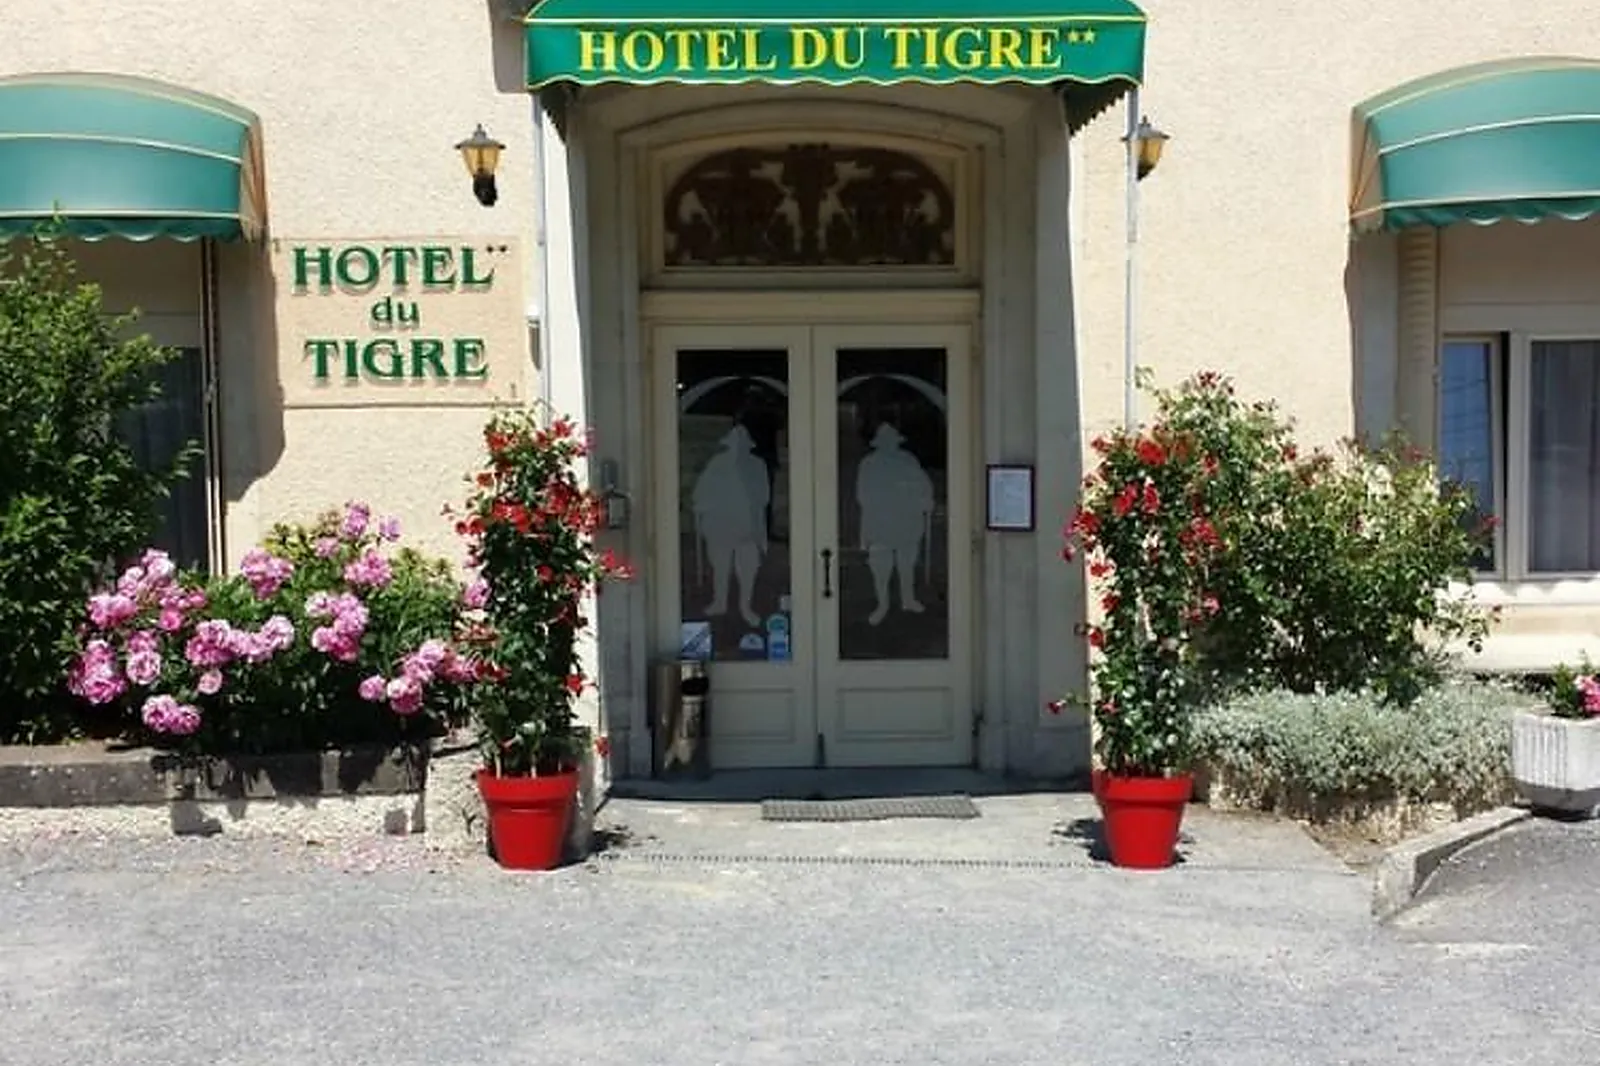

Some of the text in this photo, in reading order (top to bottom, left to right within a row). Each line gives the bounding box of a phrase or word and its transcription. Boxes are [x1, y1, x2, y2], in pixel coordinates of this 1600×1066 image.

[578, 27, 1062, 72] HOTEL DU TIGRE
[293, 246, 495, 286] HOTEL
[371, 295, 419, 322] du
[303, 338, 489, 378] TIGRE
